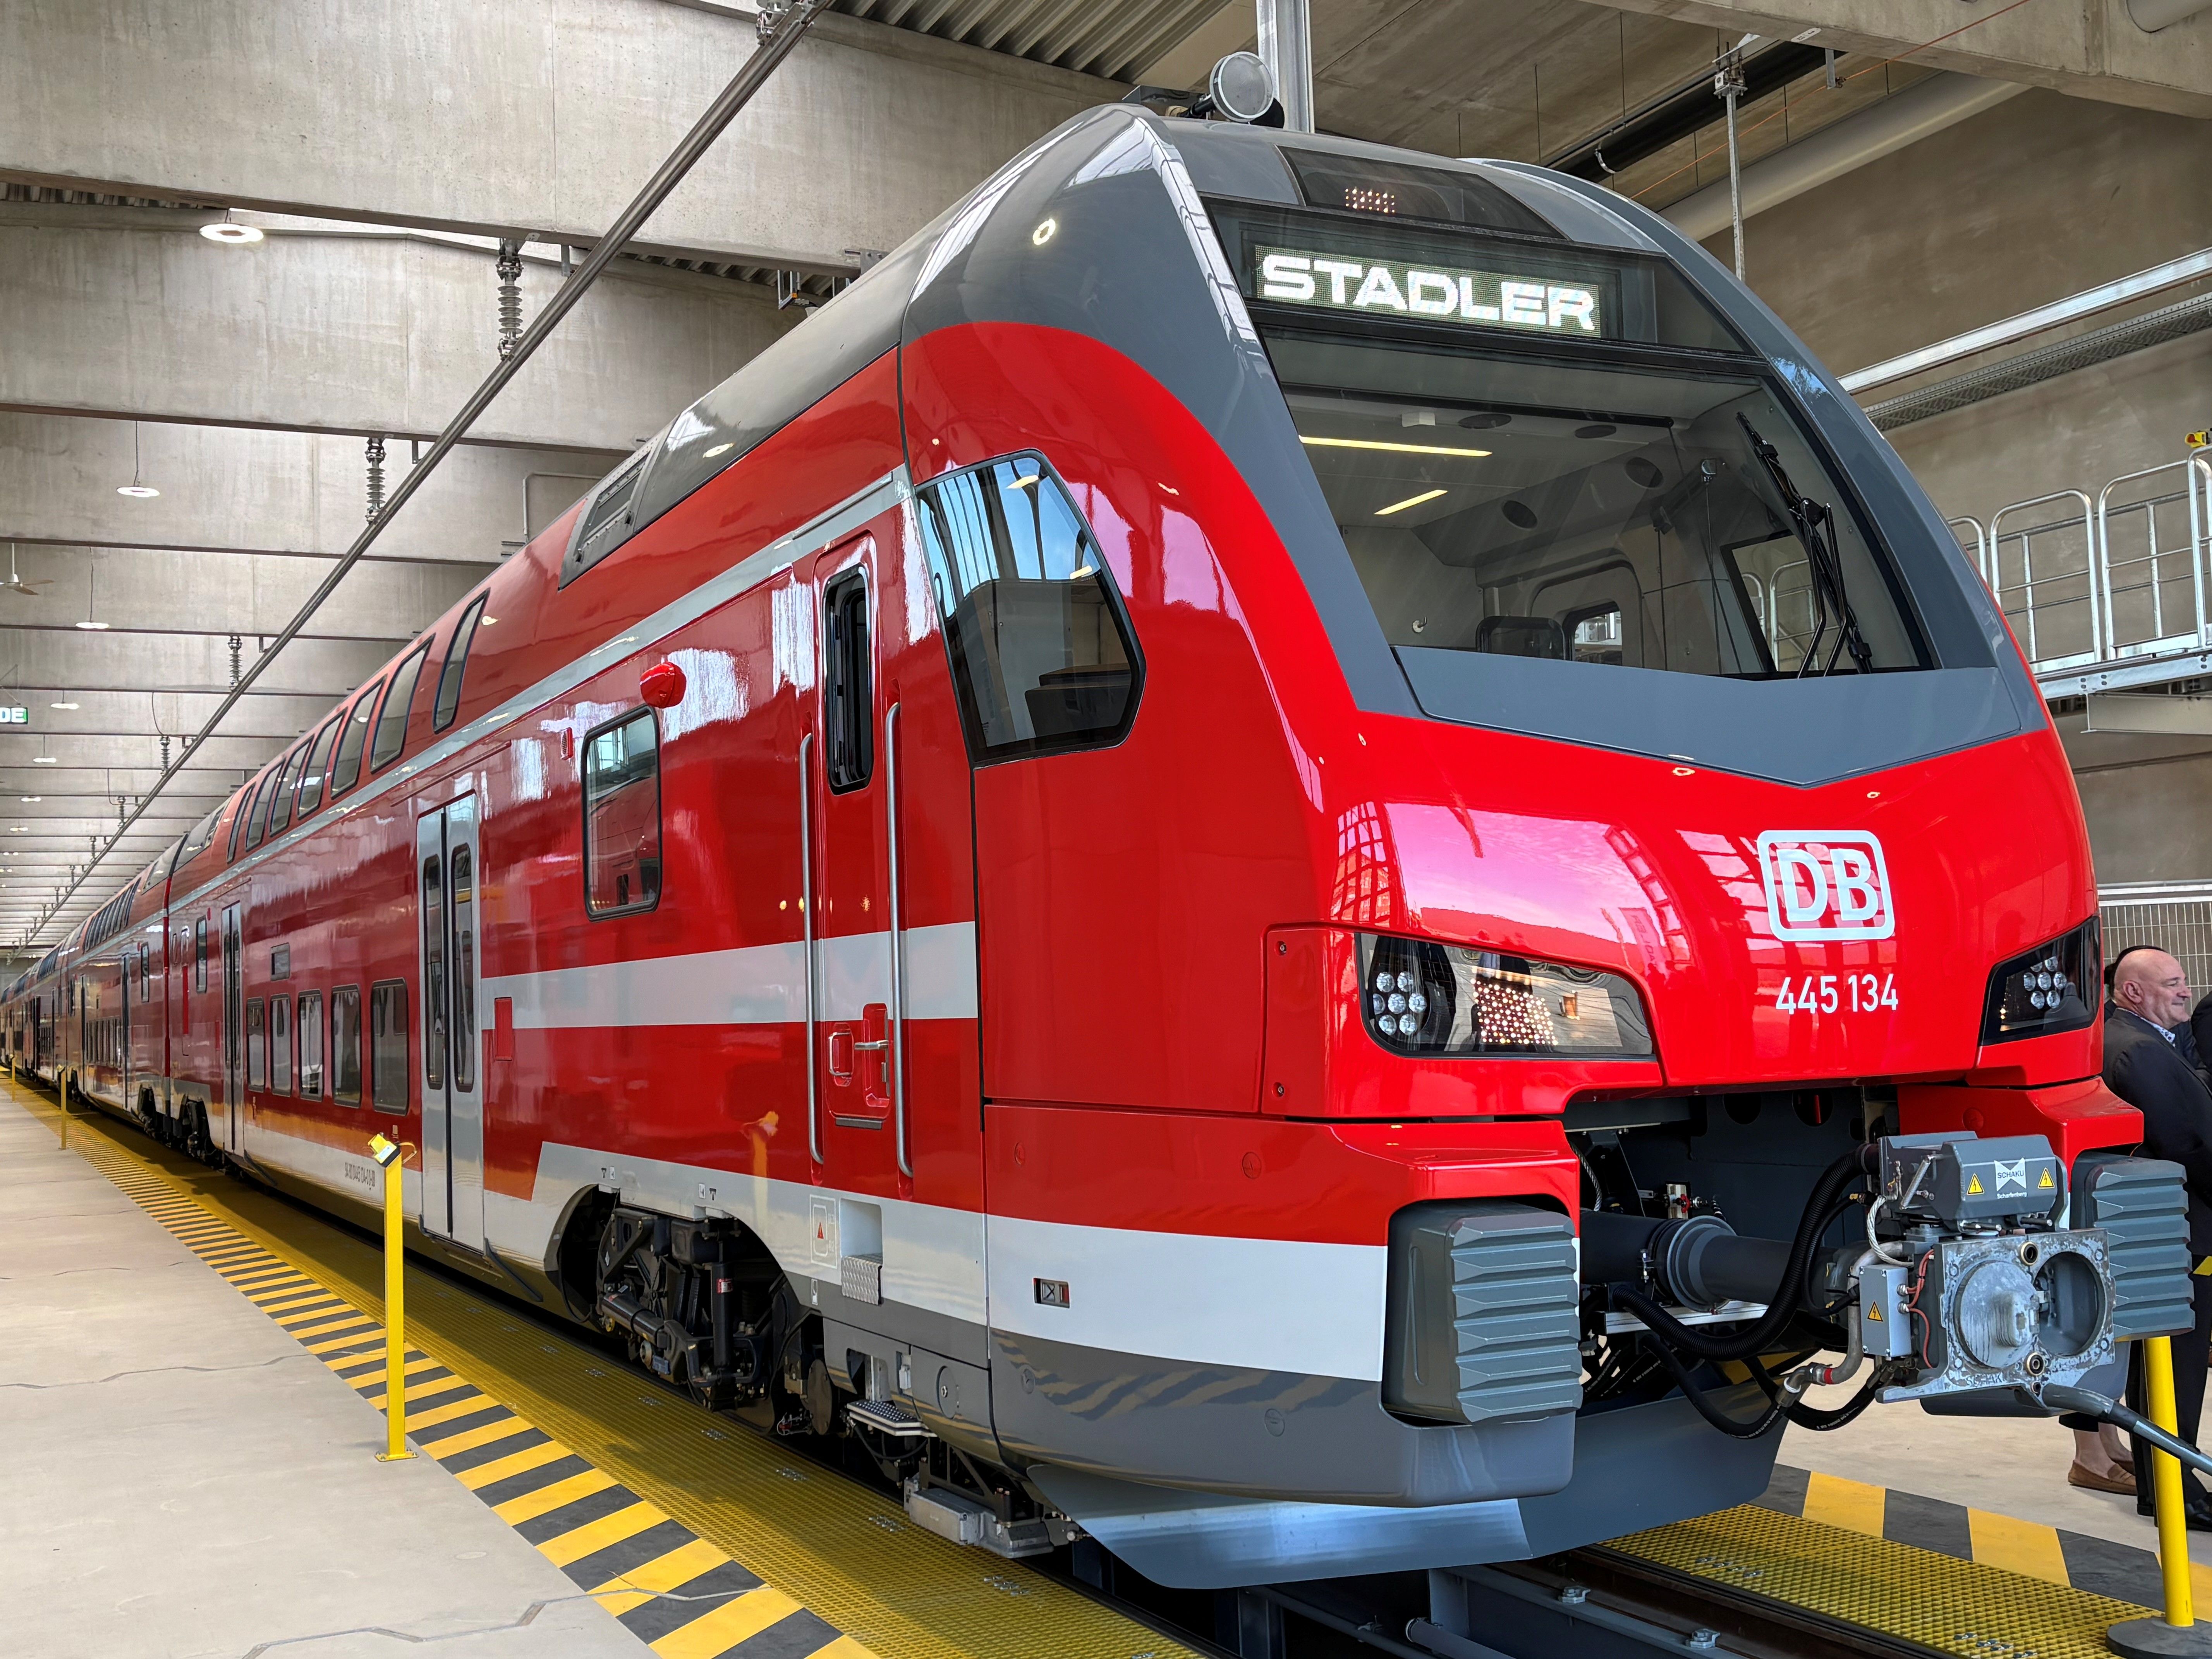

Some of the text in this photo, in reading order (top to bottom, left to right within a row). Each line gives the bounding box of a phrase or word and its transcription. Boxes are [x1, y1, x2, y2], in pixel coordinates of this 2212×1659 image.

[1262, 254, 1595, 330] STADLER
[1774, 847, 1880, 923] DB
[1776, 973, 1898, 1015] 445 134
[1997, 1170, 2024, 1178] SCHAKU
